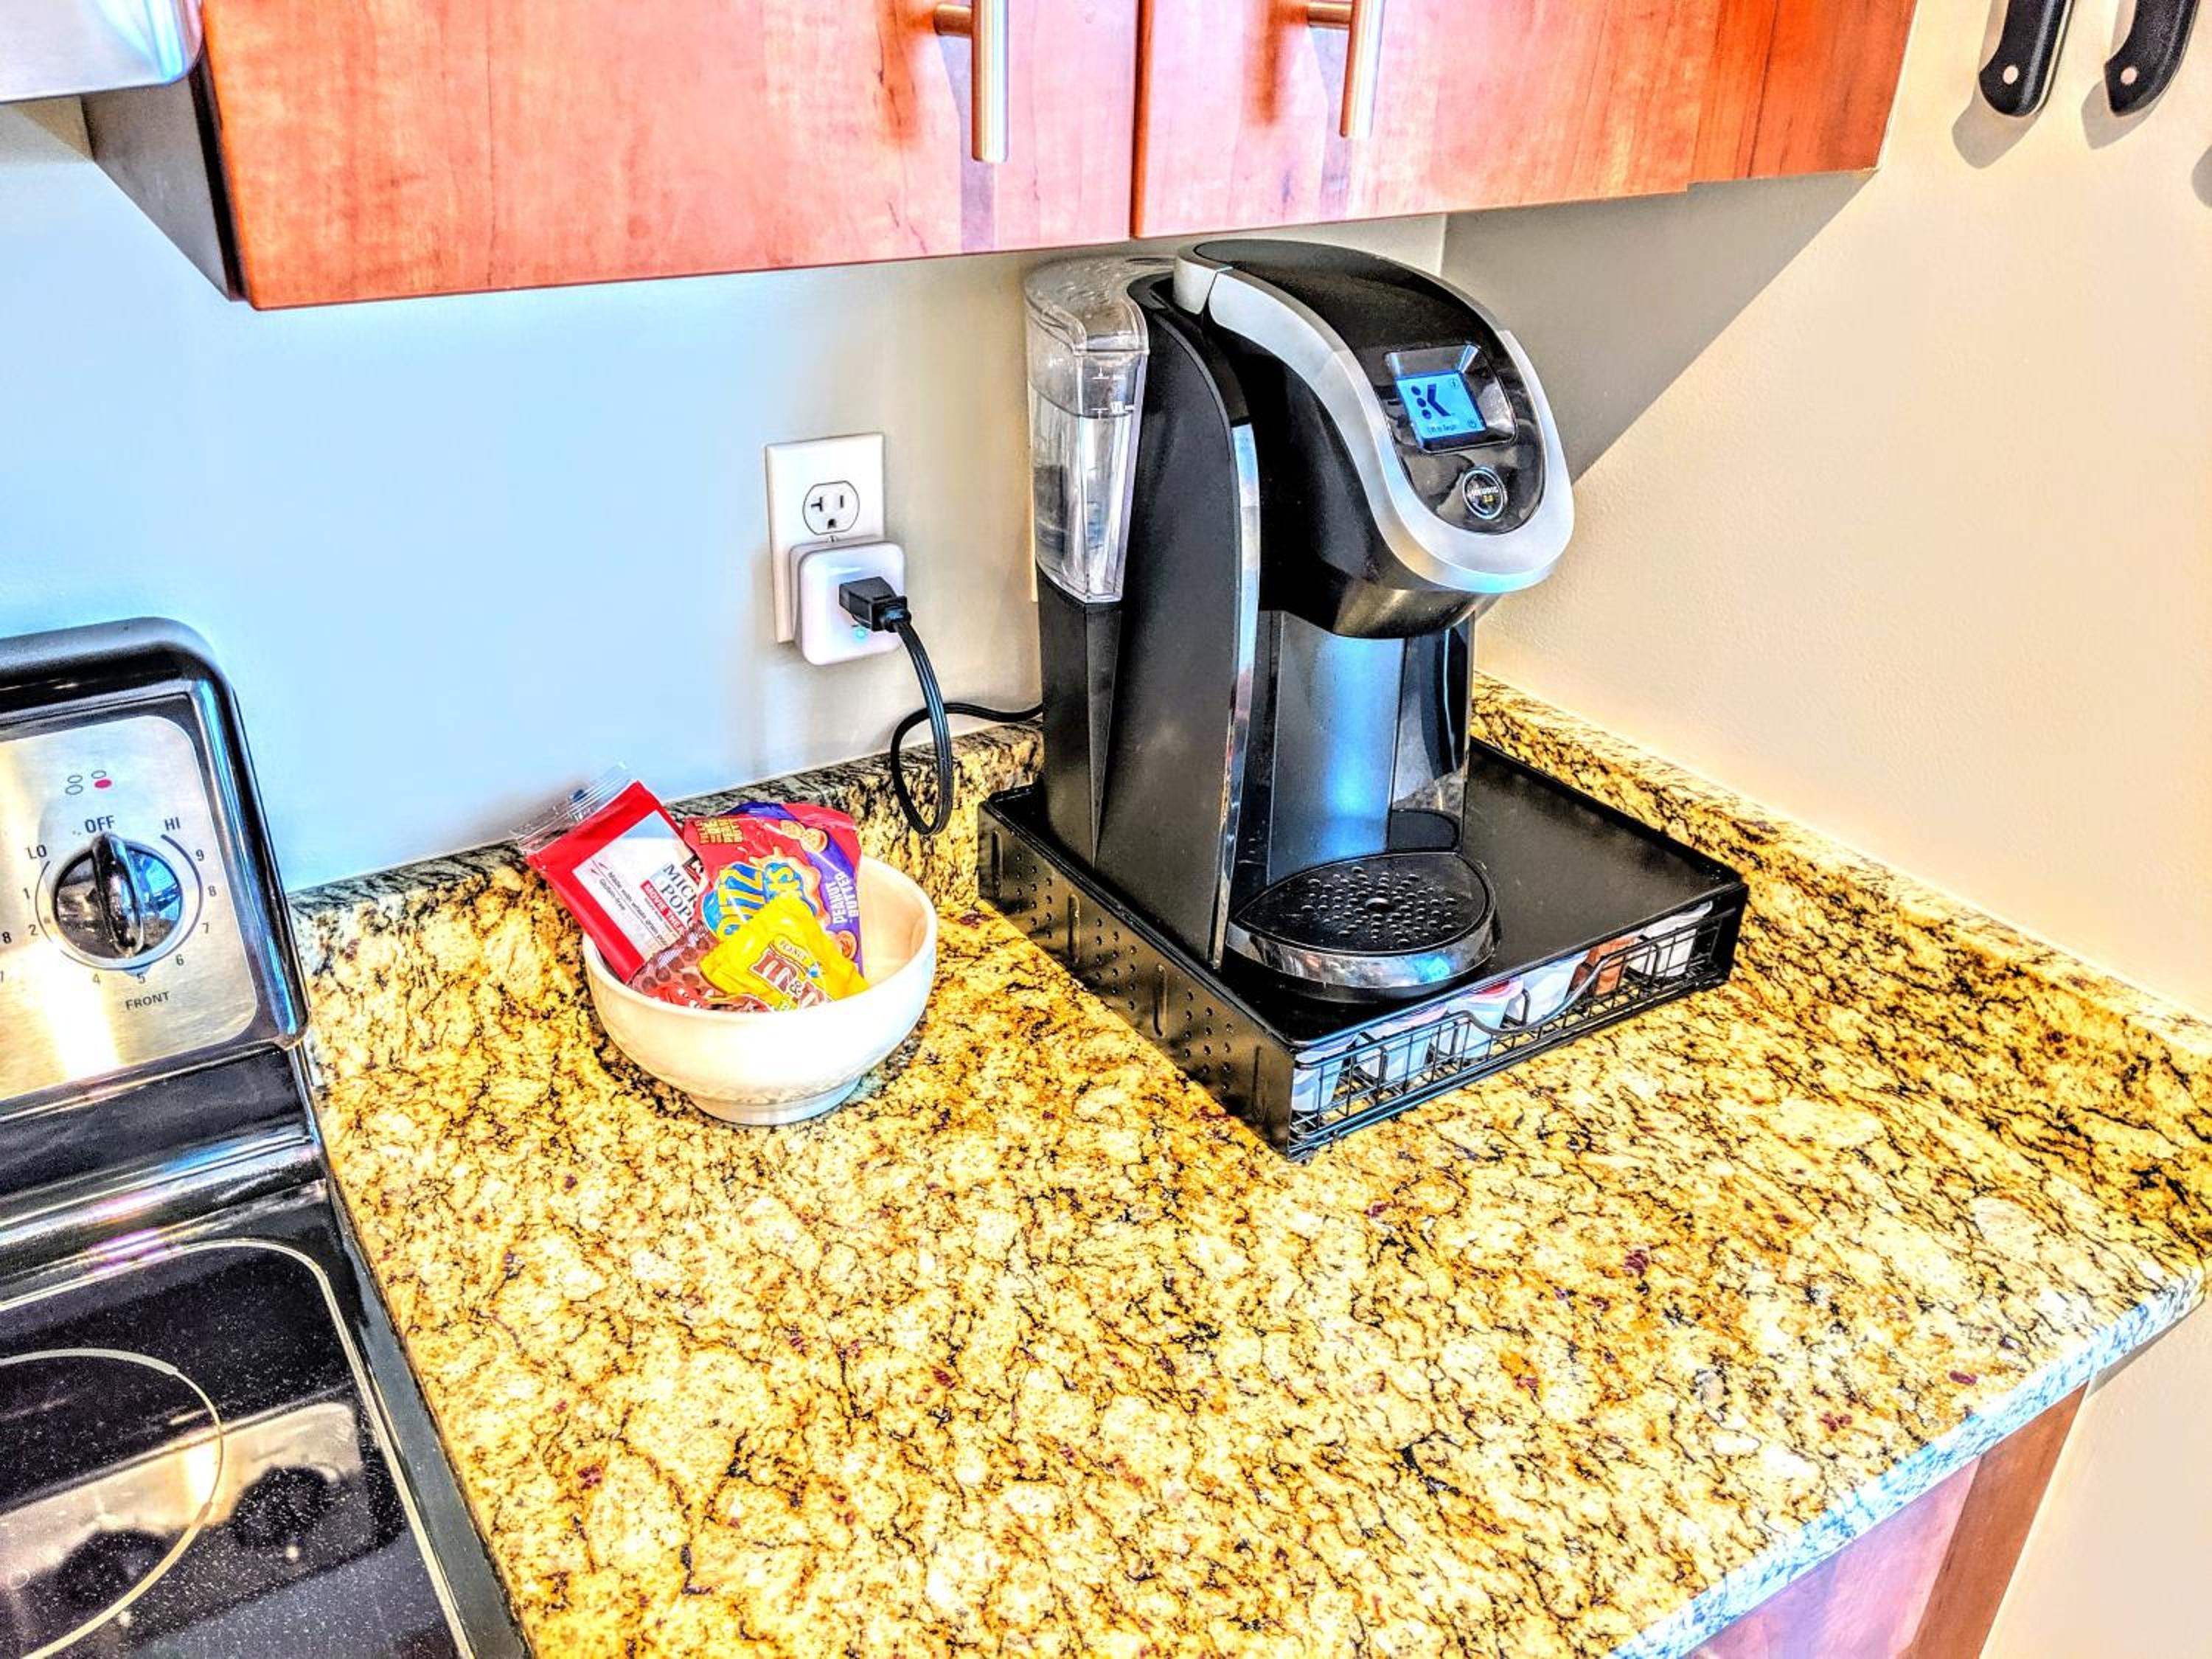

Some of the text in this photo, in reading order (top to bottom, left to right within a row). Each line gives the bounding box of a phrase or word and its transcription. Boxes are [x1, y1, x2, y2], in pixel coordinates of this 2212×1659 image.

[84, 815, 115, 833] OFF
[164, 816, 181, 831] HI
[27, 844, 47, 860] LO
[195, 849, 205, 861] 9
[24, 887, 30, 900] 1
[207, 885, 218, 897] 8
[644, 884, 667, 911] MOVIE
[834, 871, 859, 917] BUTTER
[825, 881, 848, 924] PEANUT
[28, 923, 38, 936] 2
[201, 922, 209, 934] 7
[1, 931, 13, 945] 8
[175, 953, 185, 967] 6
[92, 973, 101, 985] 4
[136, 971, 146, 984] 5
[125, 991, 170, 1011] FRONT
